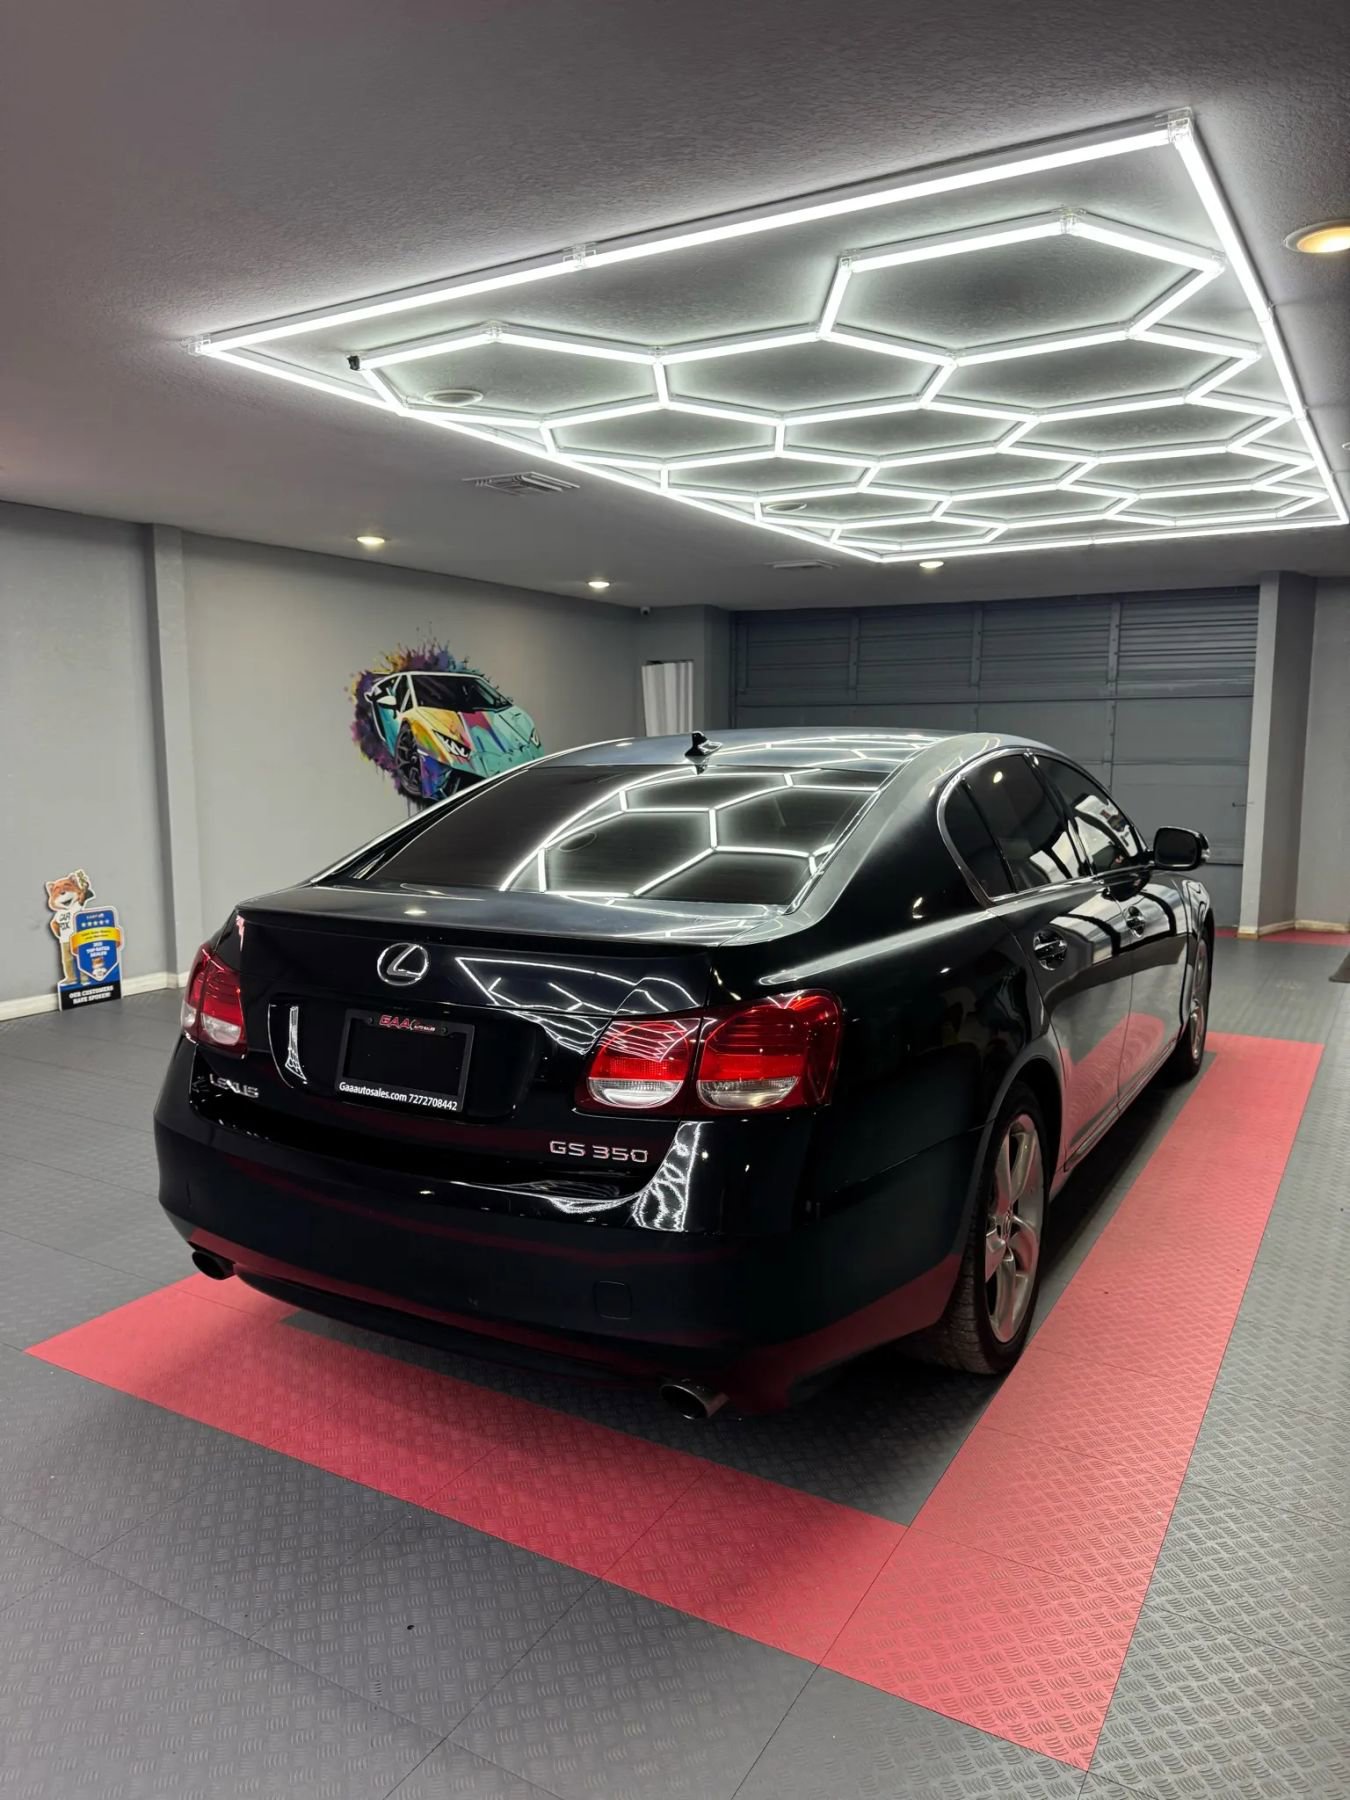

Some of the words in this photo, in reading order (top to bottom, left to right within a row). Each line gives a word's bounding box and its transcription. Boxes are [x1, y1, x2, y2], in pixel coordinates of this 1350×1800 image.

[82, 985, 114, 996] CUSTOMERS
[209, 1073, 259, 1098] LEXUS
[339, 1081, 407, 1102] Gaaautosales.com
[408, 1093, 458, 1111] 7272708442
[549, 1140, 586, 1157] GS
[592, 1144, 648, 1163] 350
